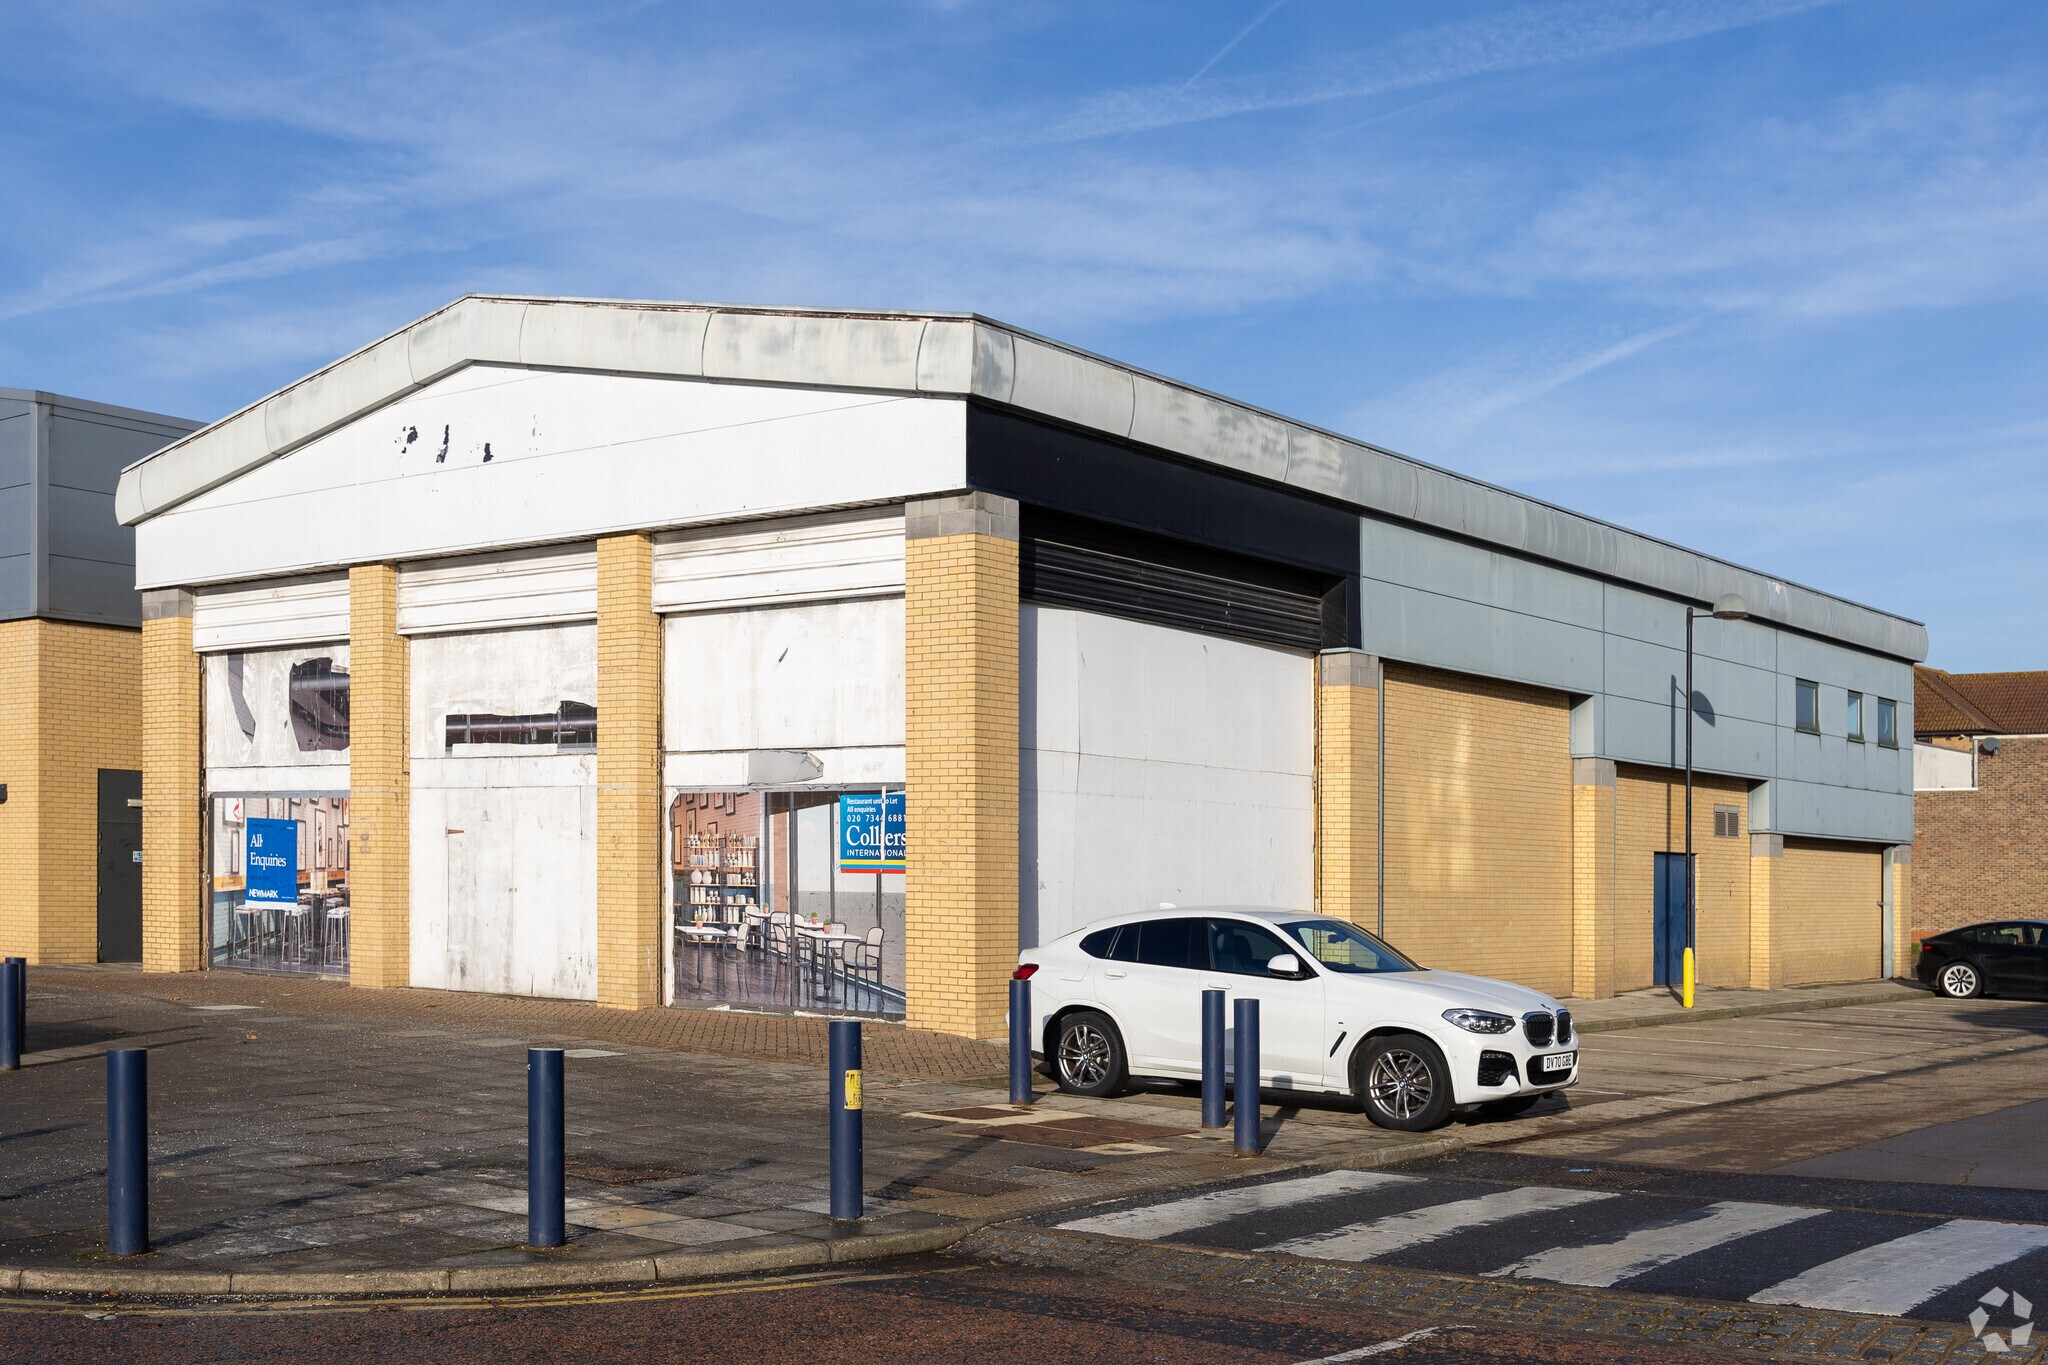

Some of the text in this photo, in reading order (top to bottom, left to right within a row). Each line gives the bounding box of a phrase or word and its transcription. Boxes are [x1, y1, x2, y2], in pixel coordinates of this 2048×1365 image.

[890, 797, 898, 805] Let
[854, 806, 876, 814] enquiries
[846, 825, 906, 846] Collers
[250, 852, 286, 870] Enquiries
[248, 888, 278, 899] NEWMARK
[1546, 1056, 1561, 1068] DV70
